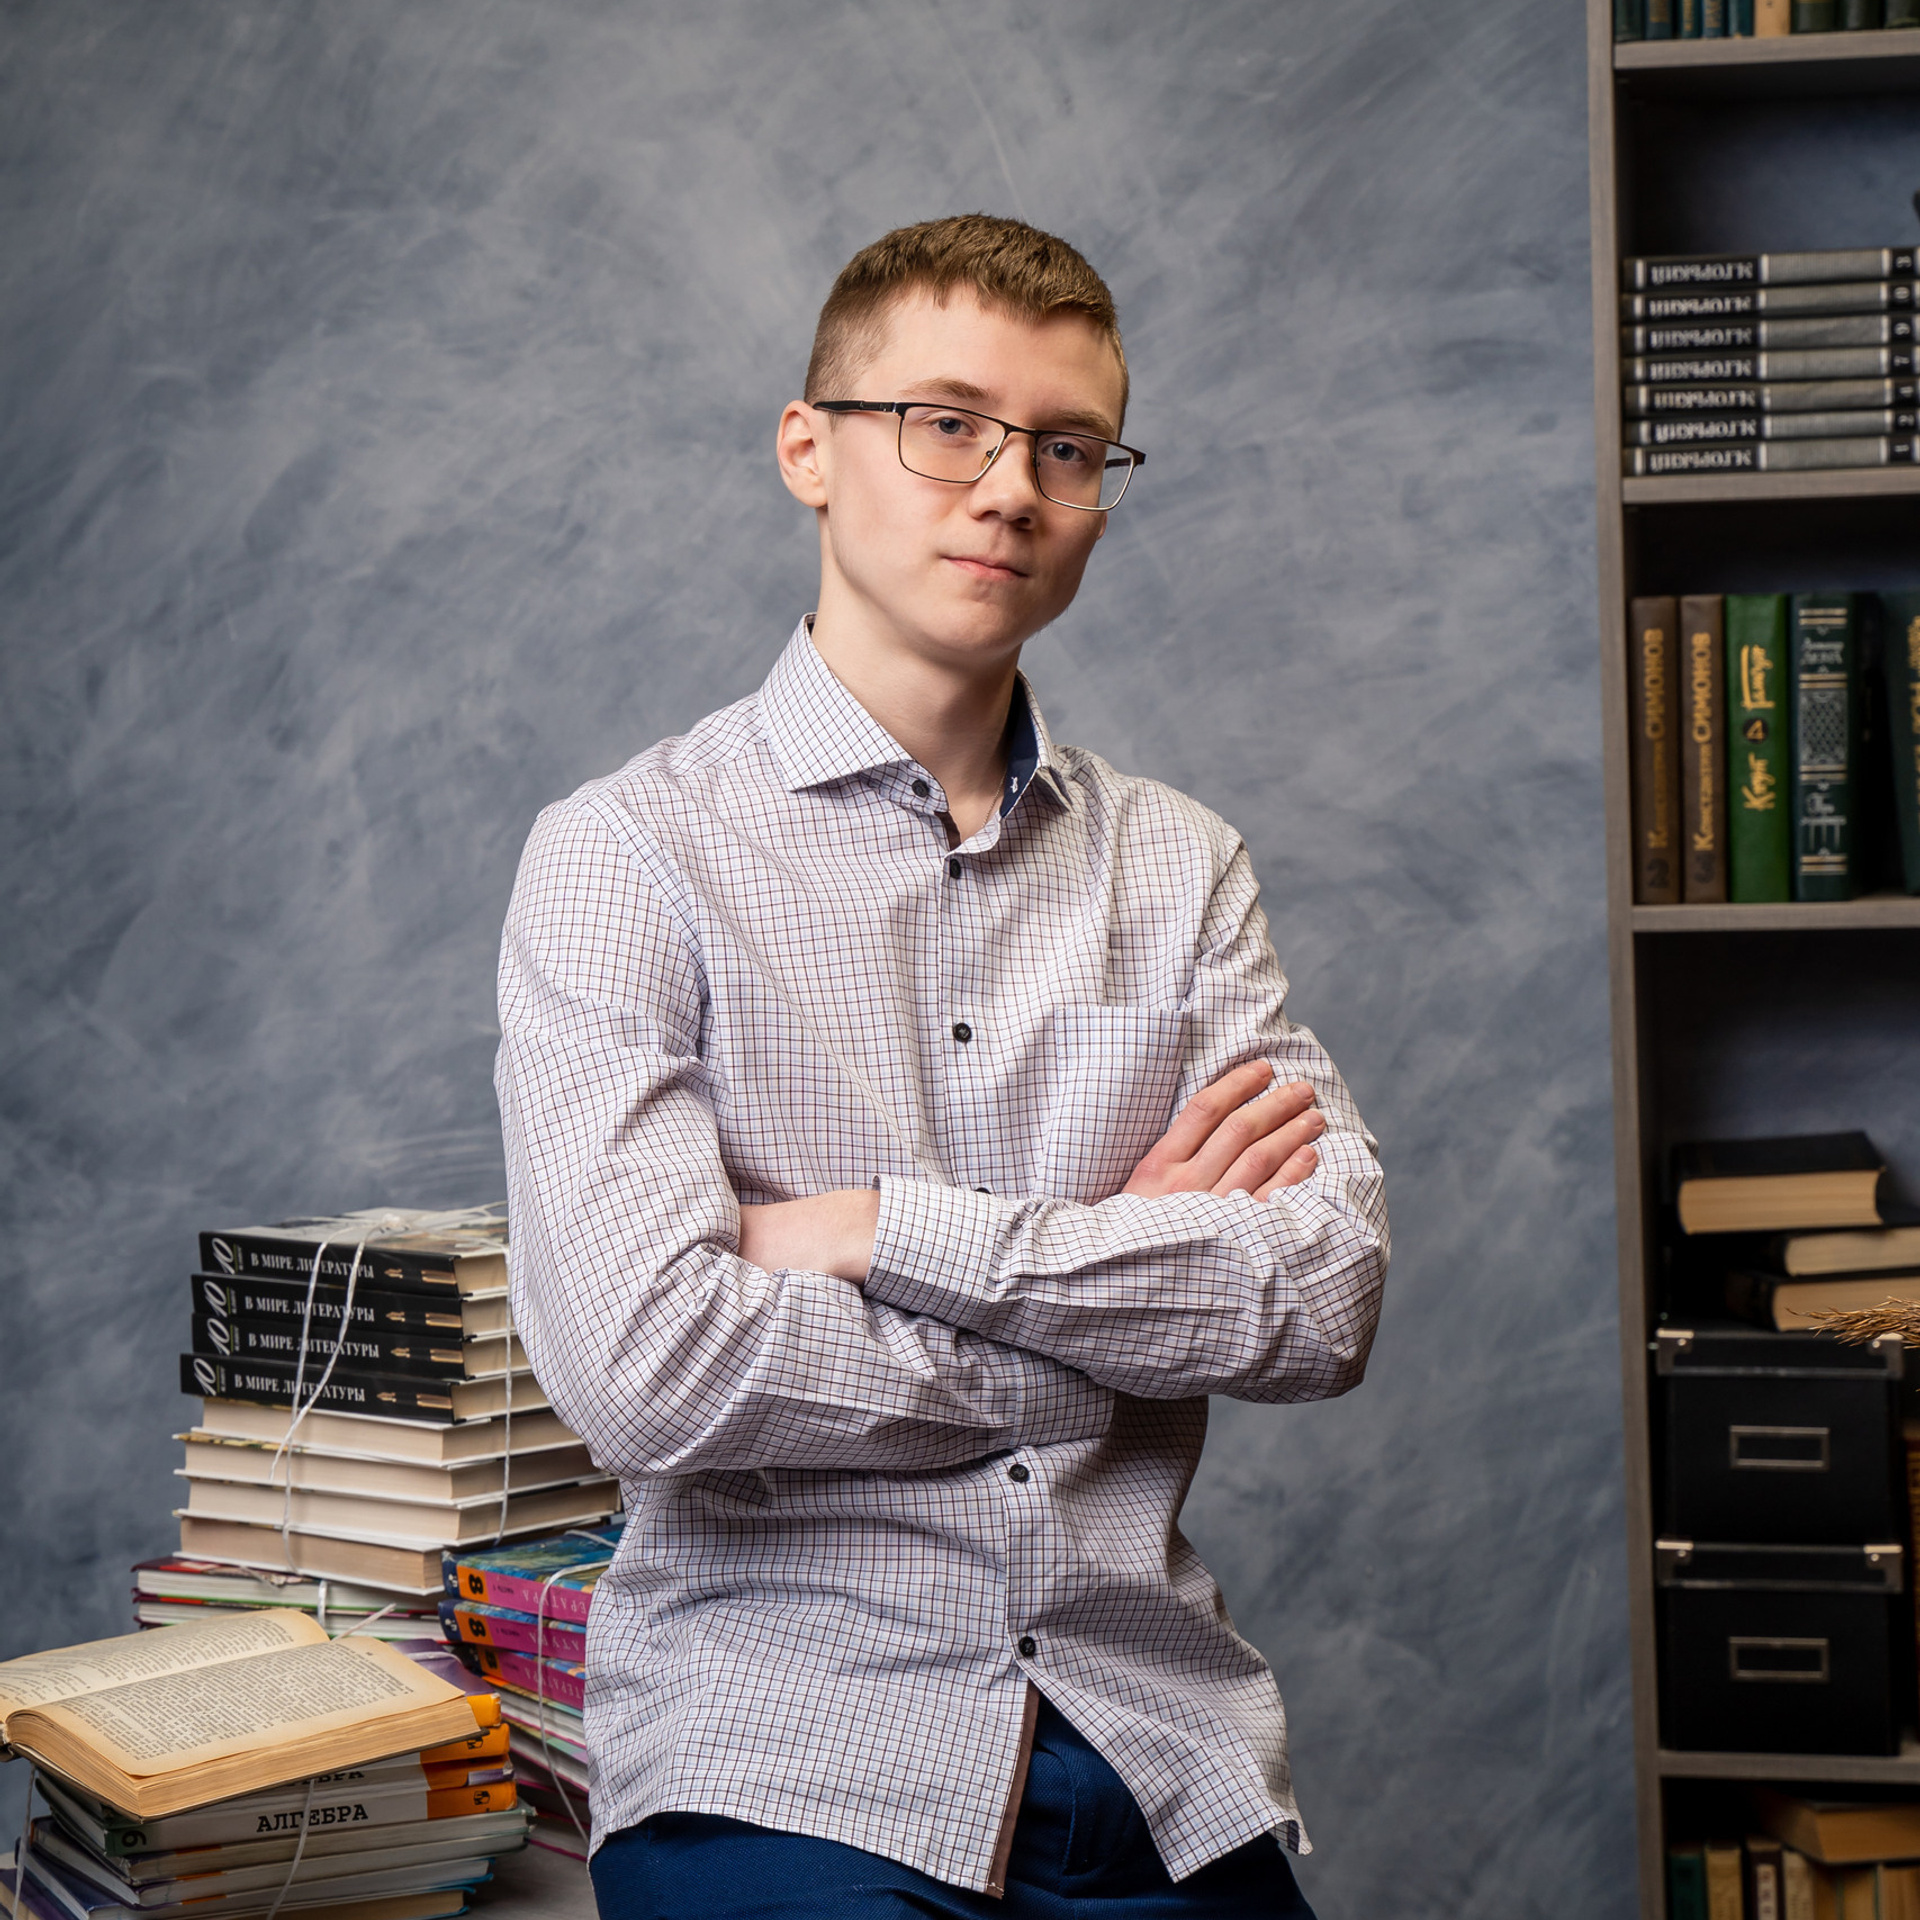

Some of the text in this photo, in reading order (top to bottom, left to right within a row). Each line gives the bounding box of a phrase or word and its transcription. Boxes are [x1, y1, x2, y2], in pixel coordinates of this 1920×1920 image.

[1643, 628, 1665, 739] СИМОНОВ
[1691, 633, 1712, 743] СИМОНОВ
[1746, 720, 1764, 740] 4
[1647, 858, 1670, 889] 2
[211, 1237, 235, 1275] 10
[251, 1252, 259, 1267] В
[261, 1254, 294, 1270] МИРЕ
[296, 1257, 374, 1278] ЛИЕРАТРЫ
[203, 1280, 228, 1318] 10
[244, 1295, 254, 1310] В
[256, 1297, 290, 1314] МИРЕ
[207, 1317, 230, 1356] 10
[248, 1332, 257, 1347] В
[260, 1334, 293, 1351] МИРЕ
[193, 1358, 217, 1396] 10
[234, 1374, 243, 1388] В
[246, 1375, 279, 1392] МИРЕ
[282, 1379, 365, 1402] ЛТЕАТУРЫ
[468, 1573, 484, 1595] 8
[468, 1617, 486, 1637] 8
[256, 1804, 369, 1832] АЛГЕБРА
